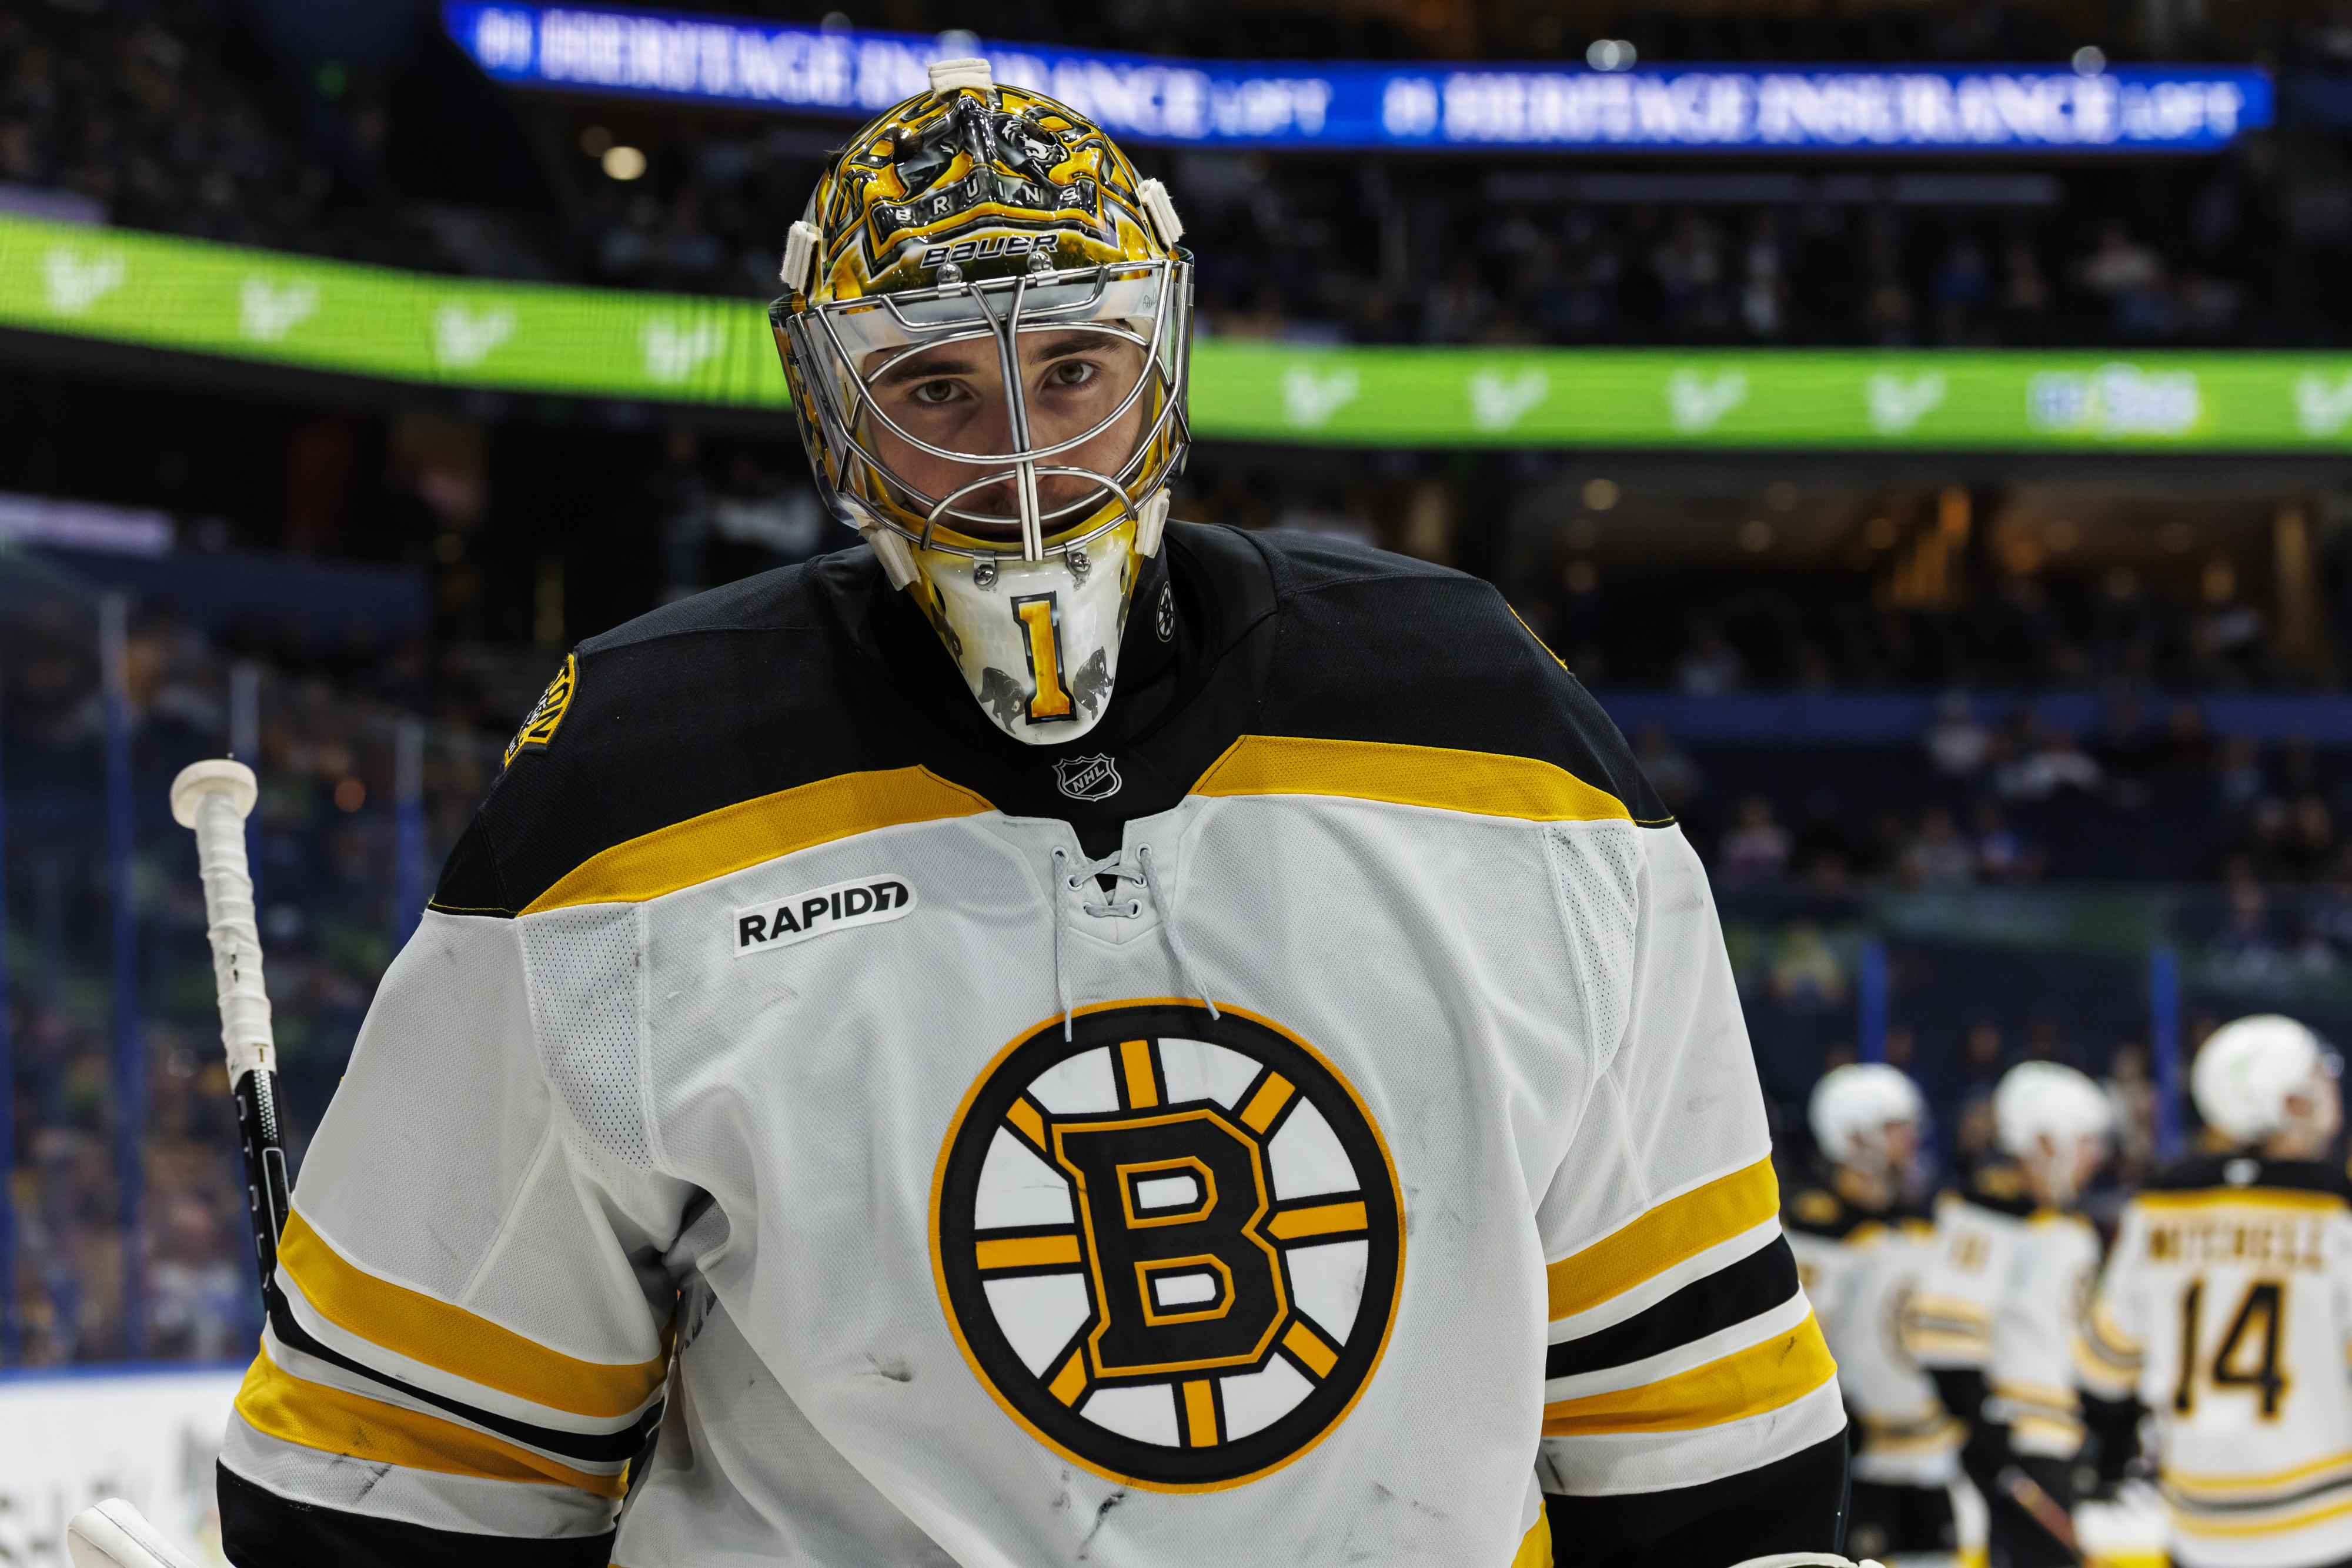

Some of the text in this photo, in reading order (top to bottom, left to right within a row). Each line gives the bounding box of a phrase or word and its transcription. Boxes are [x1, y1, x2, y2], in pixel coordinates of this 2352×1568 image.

[896, 178, 1078, 221] BRUINS
[920, 234, 1059, 269] BAUER
[1011, 590, 1078, 726] 1
[1073, 766, 1105, 792] NHL
[739, 881, 909, 947] RAPID7
[1051, 1109, 1289, 1379] B
[2176, 1278, 2288, 1418] 14
